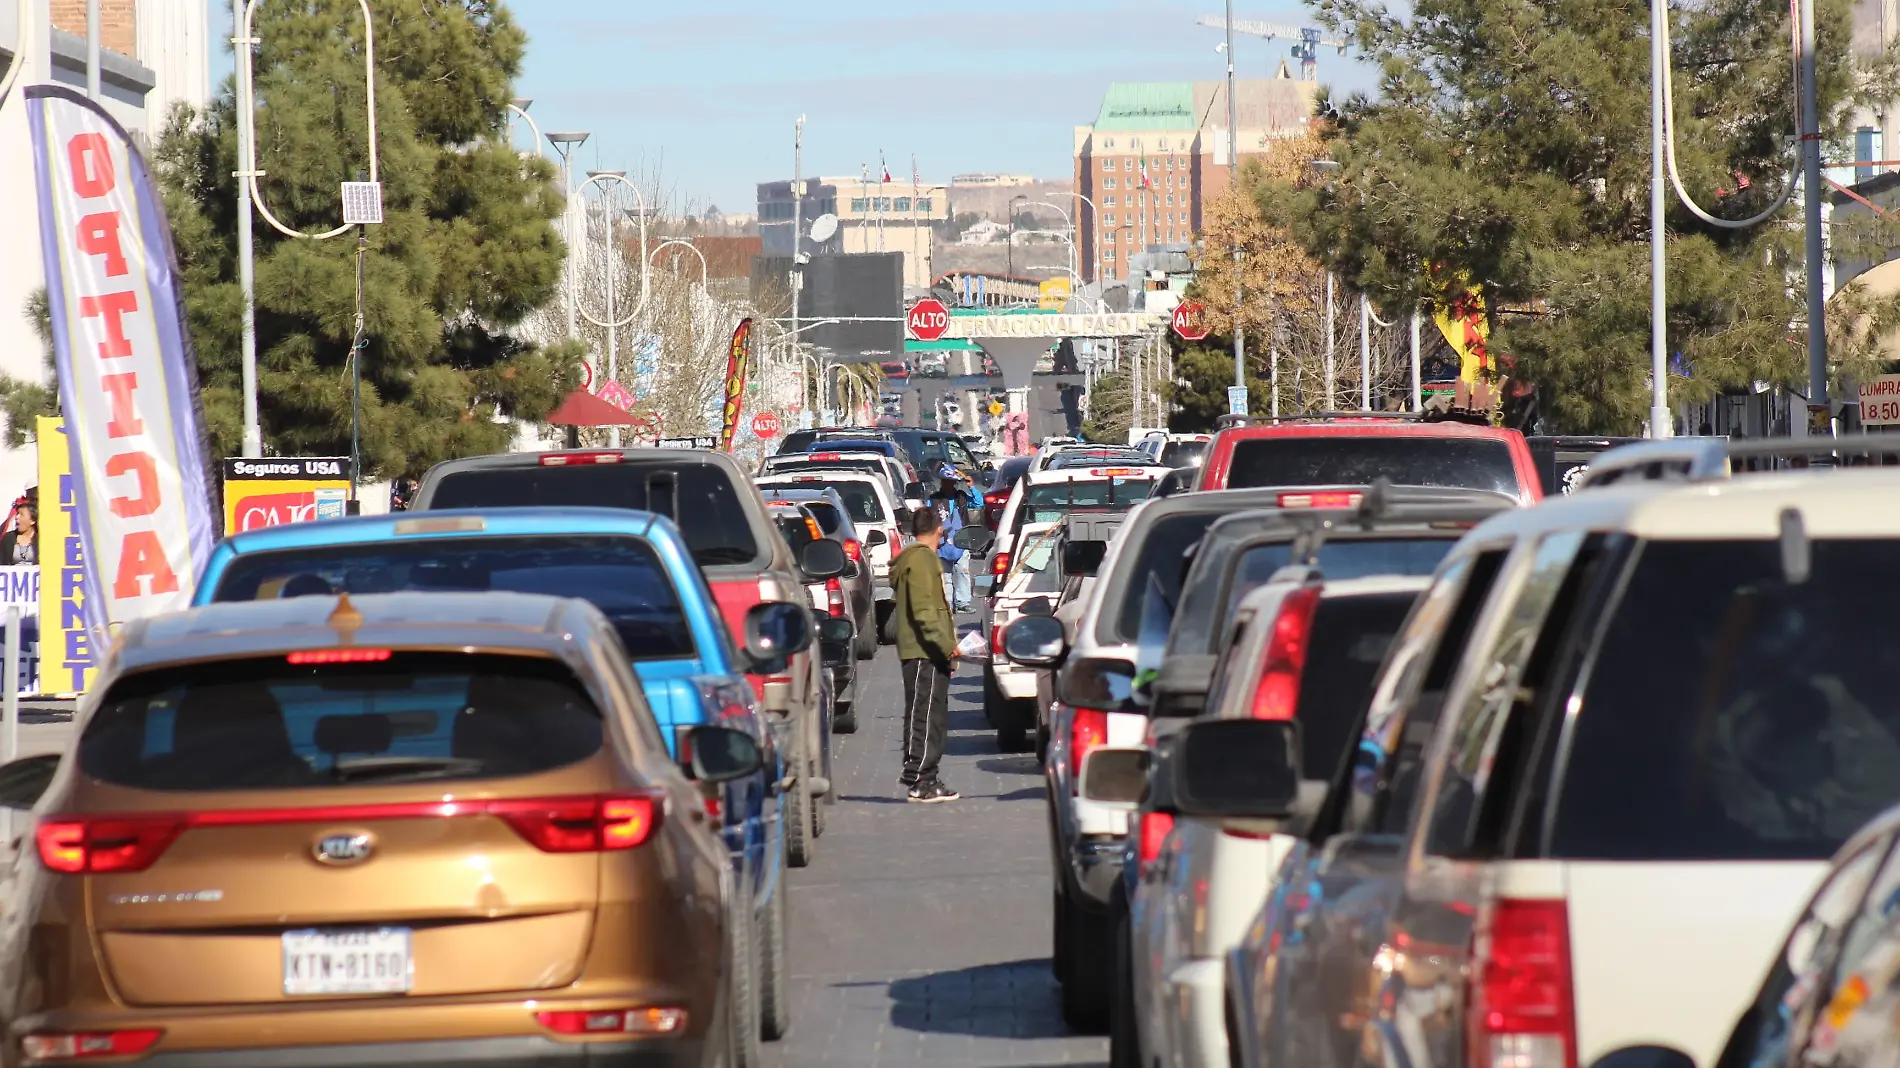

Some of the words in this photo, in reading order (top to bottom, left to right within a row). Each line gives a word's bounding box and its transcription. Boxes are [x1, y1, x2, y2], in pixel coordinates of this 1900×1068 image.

[911, 312, 947, 328] ALTO
[950, 315, 1080, 336] TERNACIONAL
[753, 420, 778, 431] ALTO
[695, 438, 713, 447] USA
[233, 461, 300, 477] Seguros
[305, 461, 341, 475] USA
